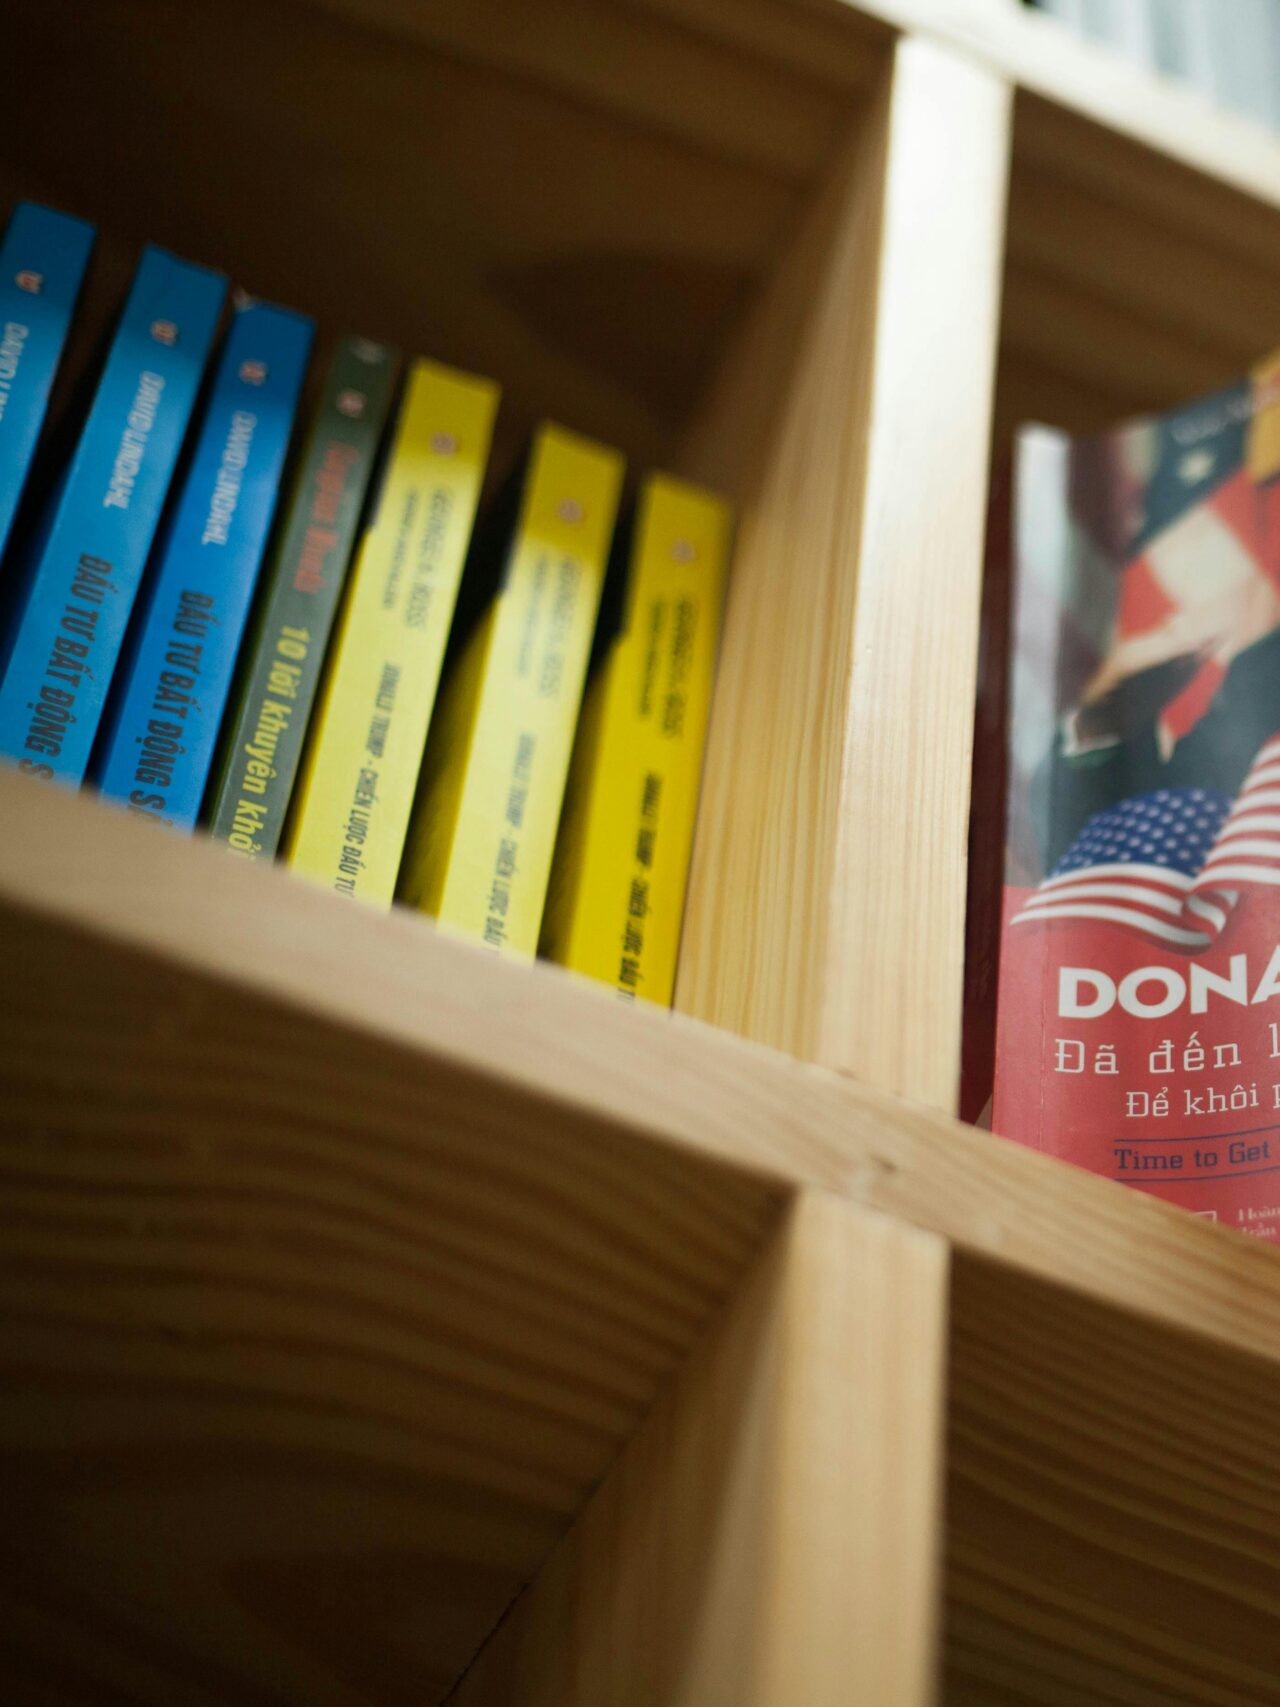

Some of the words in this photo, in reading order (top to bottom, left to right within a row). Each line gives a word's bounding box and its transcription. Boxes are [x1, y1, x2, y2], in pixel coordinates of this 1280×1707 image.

[60, 605, 97, 642] TƯ
[277, 625, 310, 660] 10
[46, 635, 94, 688] BẤT
[266, 660, 302, 699] lời
[152, 670, 201, 722] BẤT
[24, 685, 77, 757] ĐỘNG
[134, 719, 188, 787] ĐỘNG
[242, 699, 291, 794] khuyên
[1054, 1038, 1120, 1075] Đã
[1149, 1030, 1242, 1075] đến
[1126, 1087, 1169, 1118] Để
[1184, 1083, 1259, 1116] khôi
[1114, 1148, 1184, 1170] Time
[1194, 1151, 1218, 1168] to
[1229, 1140, 1269, 1164] Get
